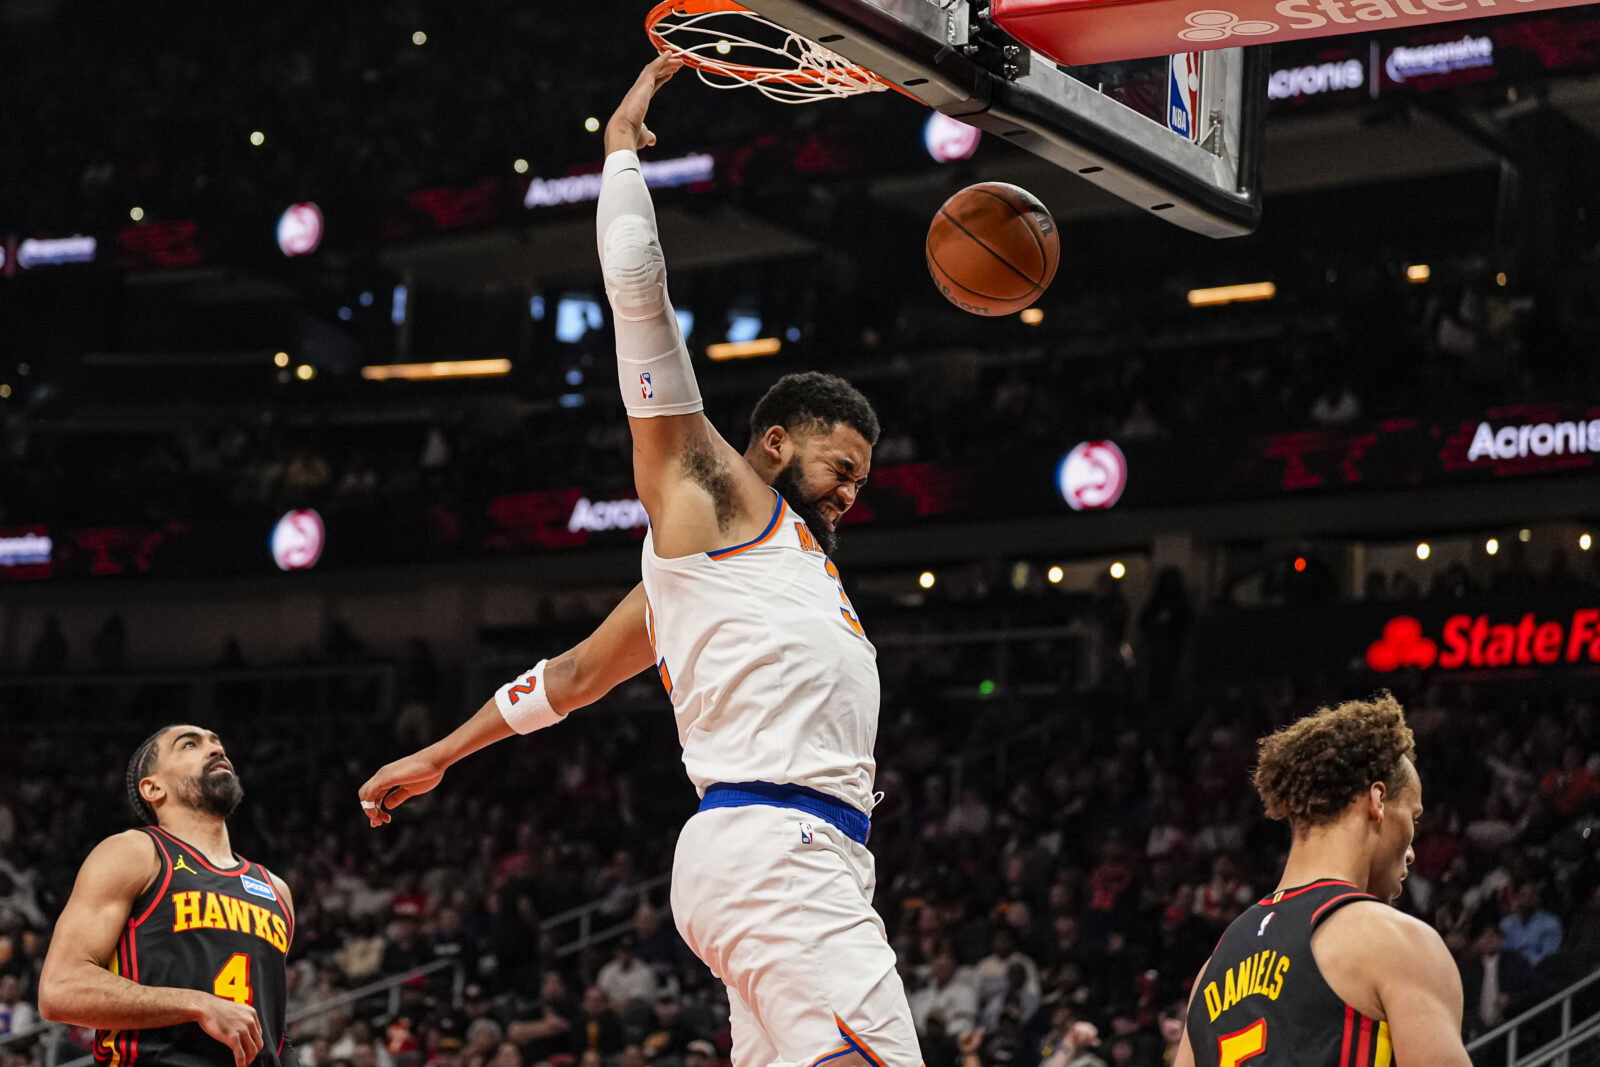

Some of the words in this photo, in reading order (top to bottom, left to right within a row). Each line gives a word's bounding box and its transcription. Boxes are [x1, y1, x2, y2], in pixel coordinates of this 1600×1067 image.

[1268, 59, 1364, 99] cronis
[1172, 105, 1187, 132] NBA
[1439, 612, 1563, 669] State
[172, 890, 288, 954] HAWKS
[214, 952, 253, 1006] 4
[1203, 950, 1290, 1023] DANIELS
[1217, 1017, 1267, 1067] 5
